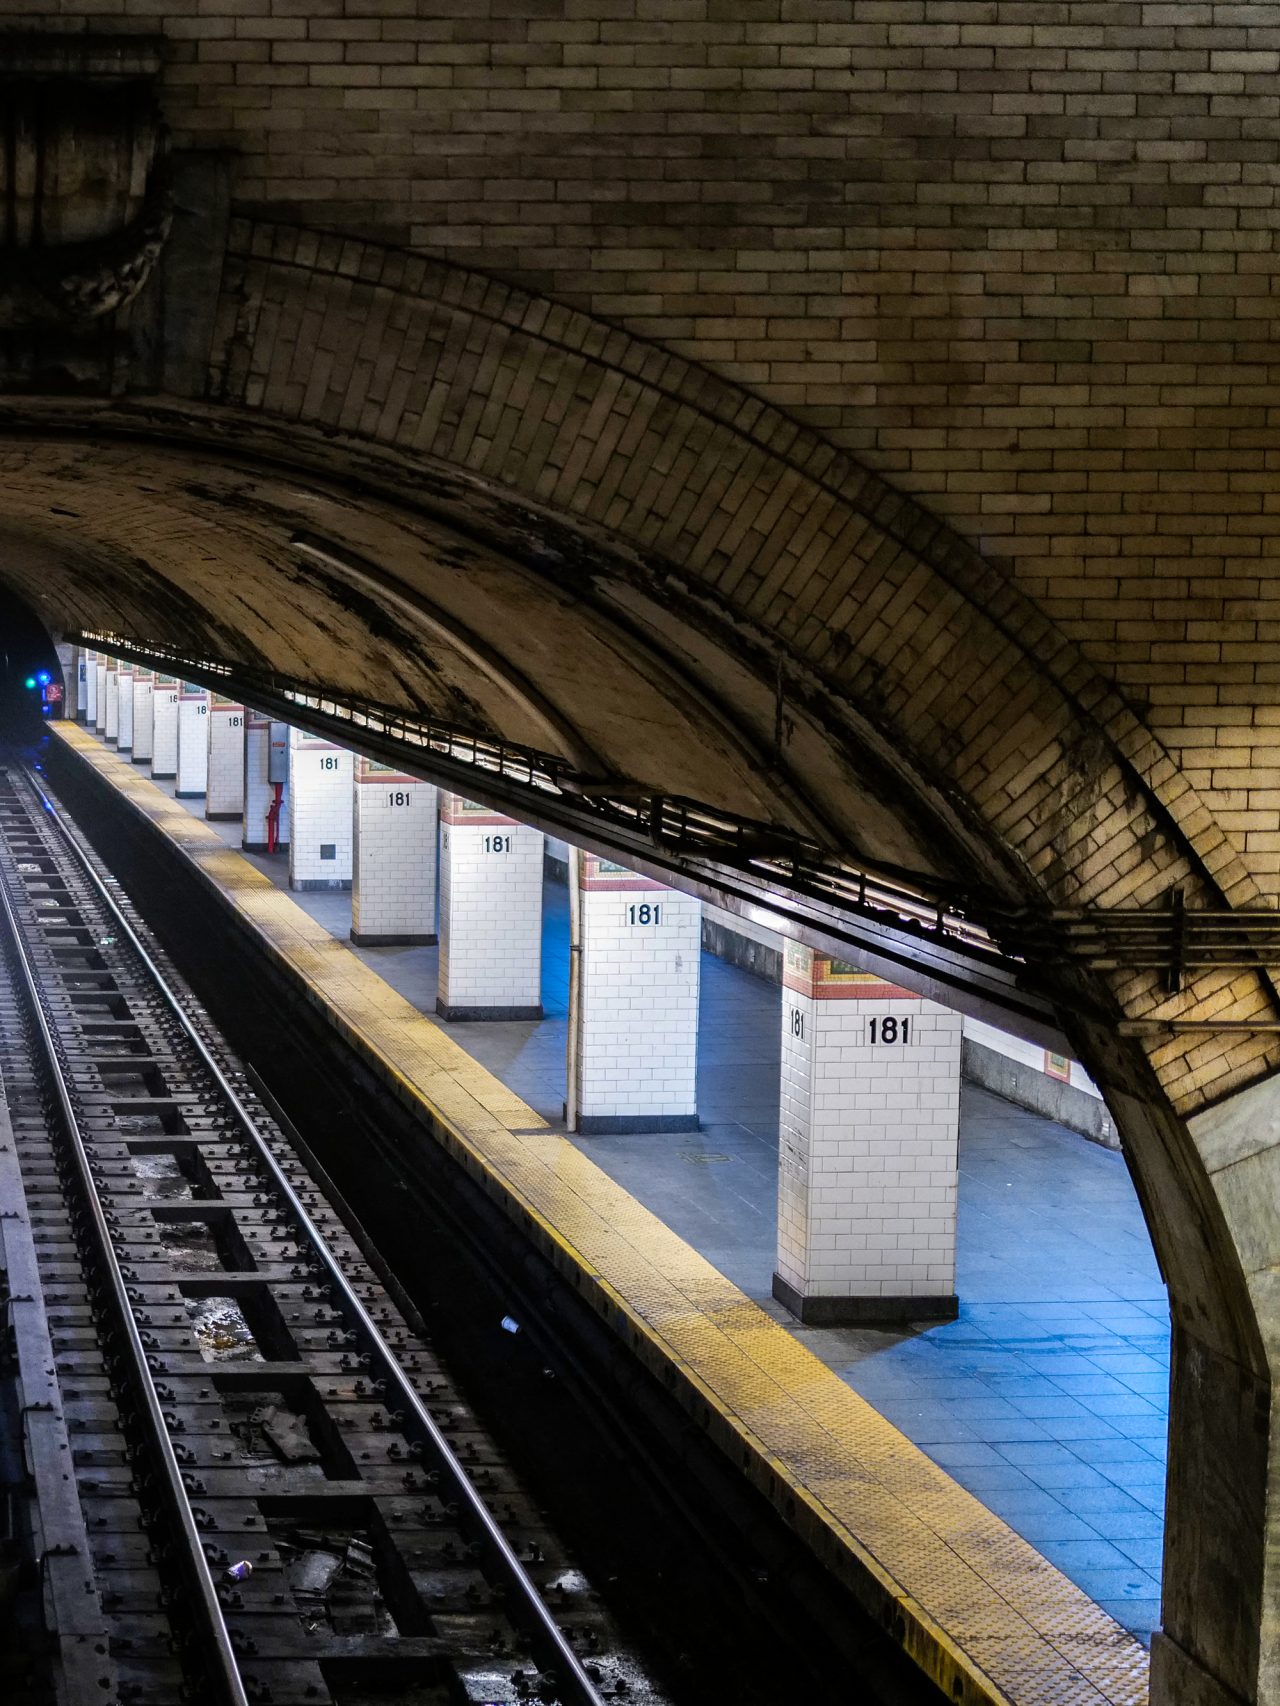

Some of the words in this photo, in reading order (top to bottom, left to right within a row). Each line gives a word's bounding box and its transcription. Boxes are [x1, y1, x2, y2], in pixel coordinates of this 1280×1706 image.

[197, 706, 207, 714] 18
[228, 717, 243, 726] 181
[320, 757, 338, 770] 181
[389, 792, 410, 807] 181
[485, 836, 510, 853] 181
[629, 904, 660, 925] 181
[790, 1008, 804, 1040] 181
[869, 1016, 909, 1044] 181
